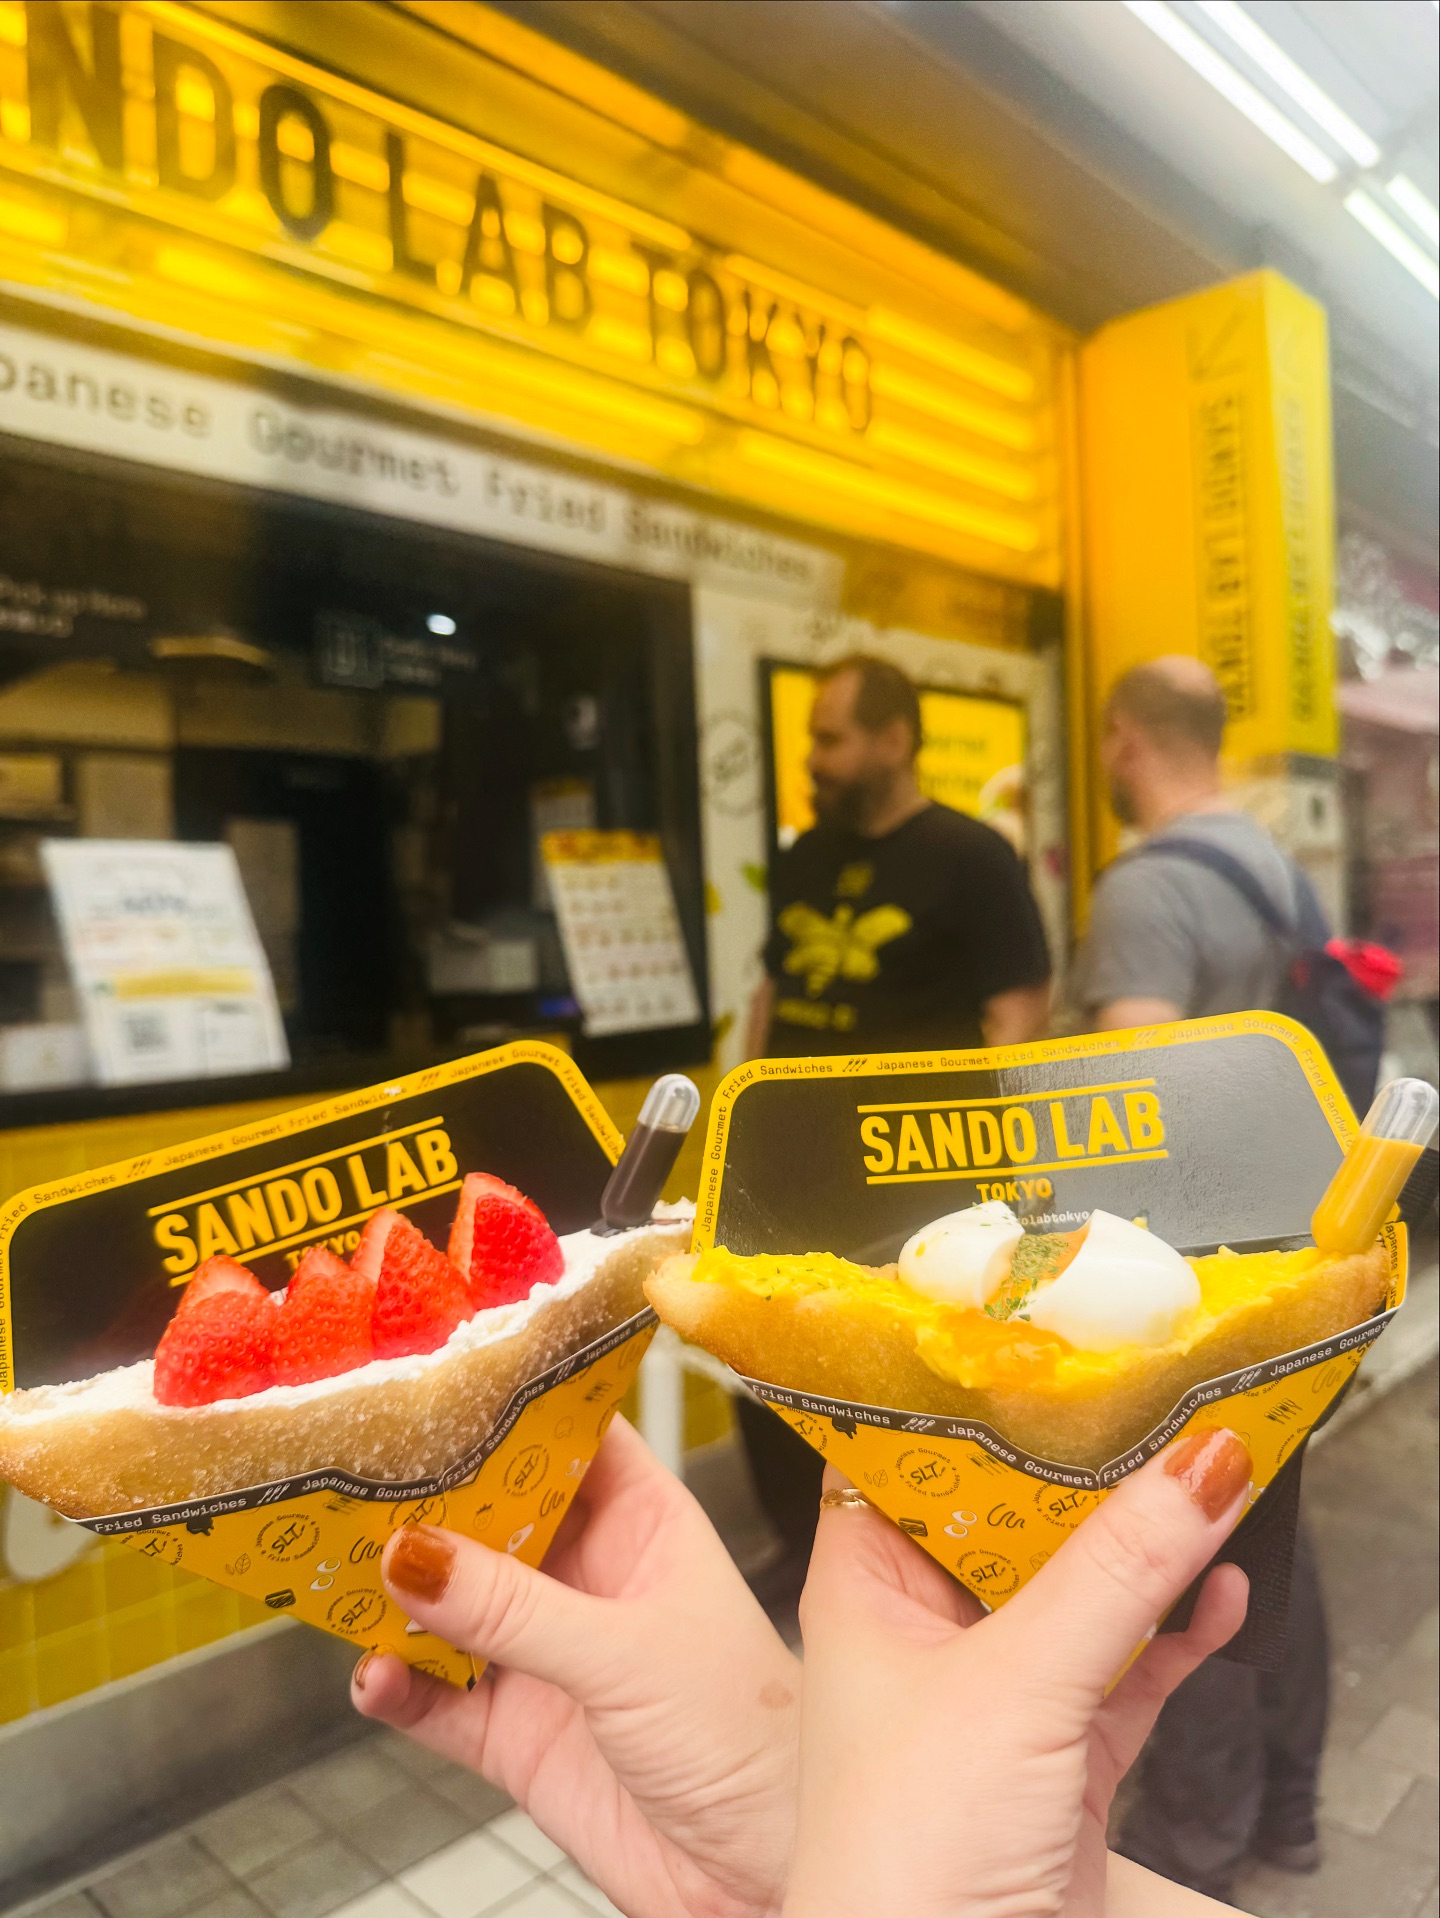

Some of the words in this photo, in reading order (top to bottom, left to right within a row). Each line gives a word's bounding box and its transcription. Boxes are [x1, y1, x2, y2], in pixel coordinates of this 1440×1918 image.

[384, 126, 592, 337] LAB
[629, 236, 873, 434] TOKYO
[451, 1057, 505, 1079] Japanese
[512, 1048, 560, 1067] Gourmet
[877, 1057, 933, 1071] Japanese
[940, 1056, 990, 1068] Gourmet
[996, 1050, 1034, 1063] Fried
[1042, 1039, 1120, 1058] Sandwiches
[1169, 1022, 1234, 1040] Japanese
[1243, 1018, 1299, 1045] Gourmet
[1301, 1049, 1328, 1088] Fried
[1323, 1093, 1356, 1149] Sandwic
[164, 1141, 225, 1166] Japanese
[232, 1124, 283, 1146] Gourmet
[289, 1110, 328, 1129] Fried
[701, 1168, 718, 1232] Japanese
[711, 1106, 727, 1160] Gourmet
[722, 1070, 754, 1099] Fried
[760, 1064, 833, 1075] Sandwiches
[861, 1107, 1037, 1173] SANDO
[1050, 1091, 1165, 1158] LAB
[33, 1173, 117, 1204] Sandwiches
[154, 1166, 343, 1274] SANDO
[347, 1129, 458, 1209] LAB
[976, 1177, 1053, 1204] TOKYO
[1018, 1210, 1091, 1226] olabtokyo
[284, 1230, 361, 1270] TYO
[583, 1326, 631, 1363] Japanese
[1270, 1346, 1332, 1376] Japanese
[1340, 1320, 1388, 1350] Gourmet
[752, 1384, 793, 1404] Fried
[801, 1398, 891, 1425] Sandwiches
[444, 1453, 483, 1484] Fried
[486, 1382, 545, 1450] Sandwiches
[1103, 1452, 1144, 1482] Fried
[1149, 1387, 1223, 1451] Sandwiches
[514, 1453, 535, 1489] SLT
[910, 1460, 939, 1485] SLT
[947, 1424, 1017, 1462] Japanese
[1024, 1460, 1093, 1486] Gourmet
[302, 1476, 369, 1496] Japanese
[376, 1482, 439, 1498] Gourmet
[1048, 1490, 1080, 1517] SLT
[94, 1517, 143, 1533] Fried
[151, 1497, 248, 1525] Sandwiches
[271, 1522, 301, 1554] SLT
[970, 1561, 999, 1584] SLT
[341, 1596, 370, 1627] SLT
